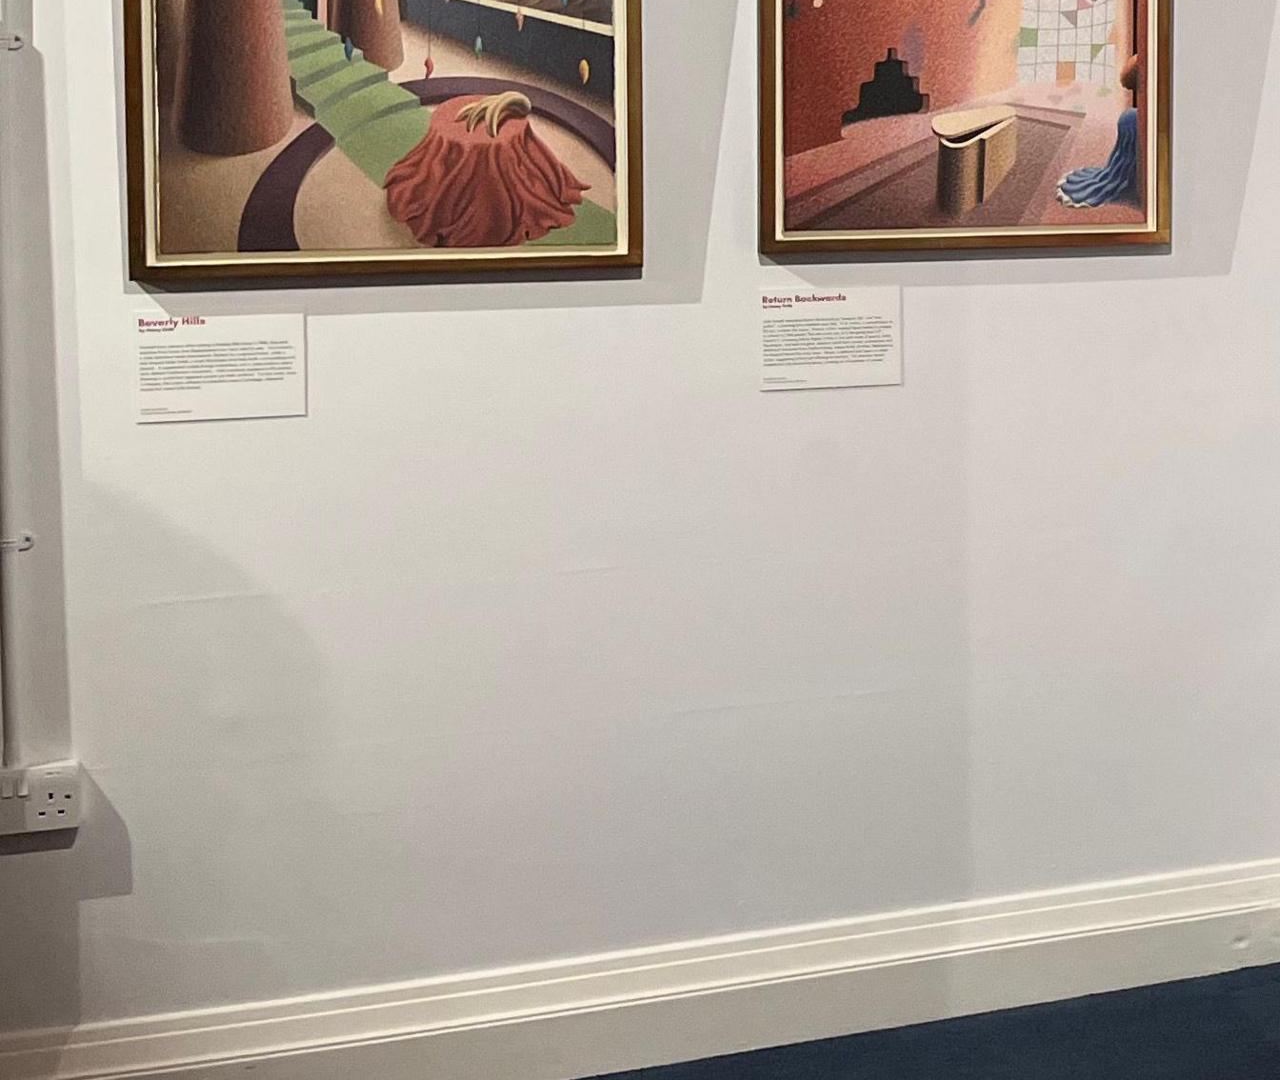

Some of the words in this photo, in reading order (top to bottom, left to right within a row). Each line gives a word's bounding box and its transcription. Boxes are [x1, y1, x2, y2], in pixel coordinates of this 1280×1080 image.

[762, 295, 793, 304] Return
[138, 316, 179, 328] Beverly
[182, 315, 206, 326] Hills
